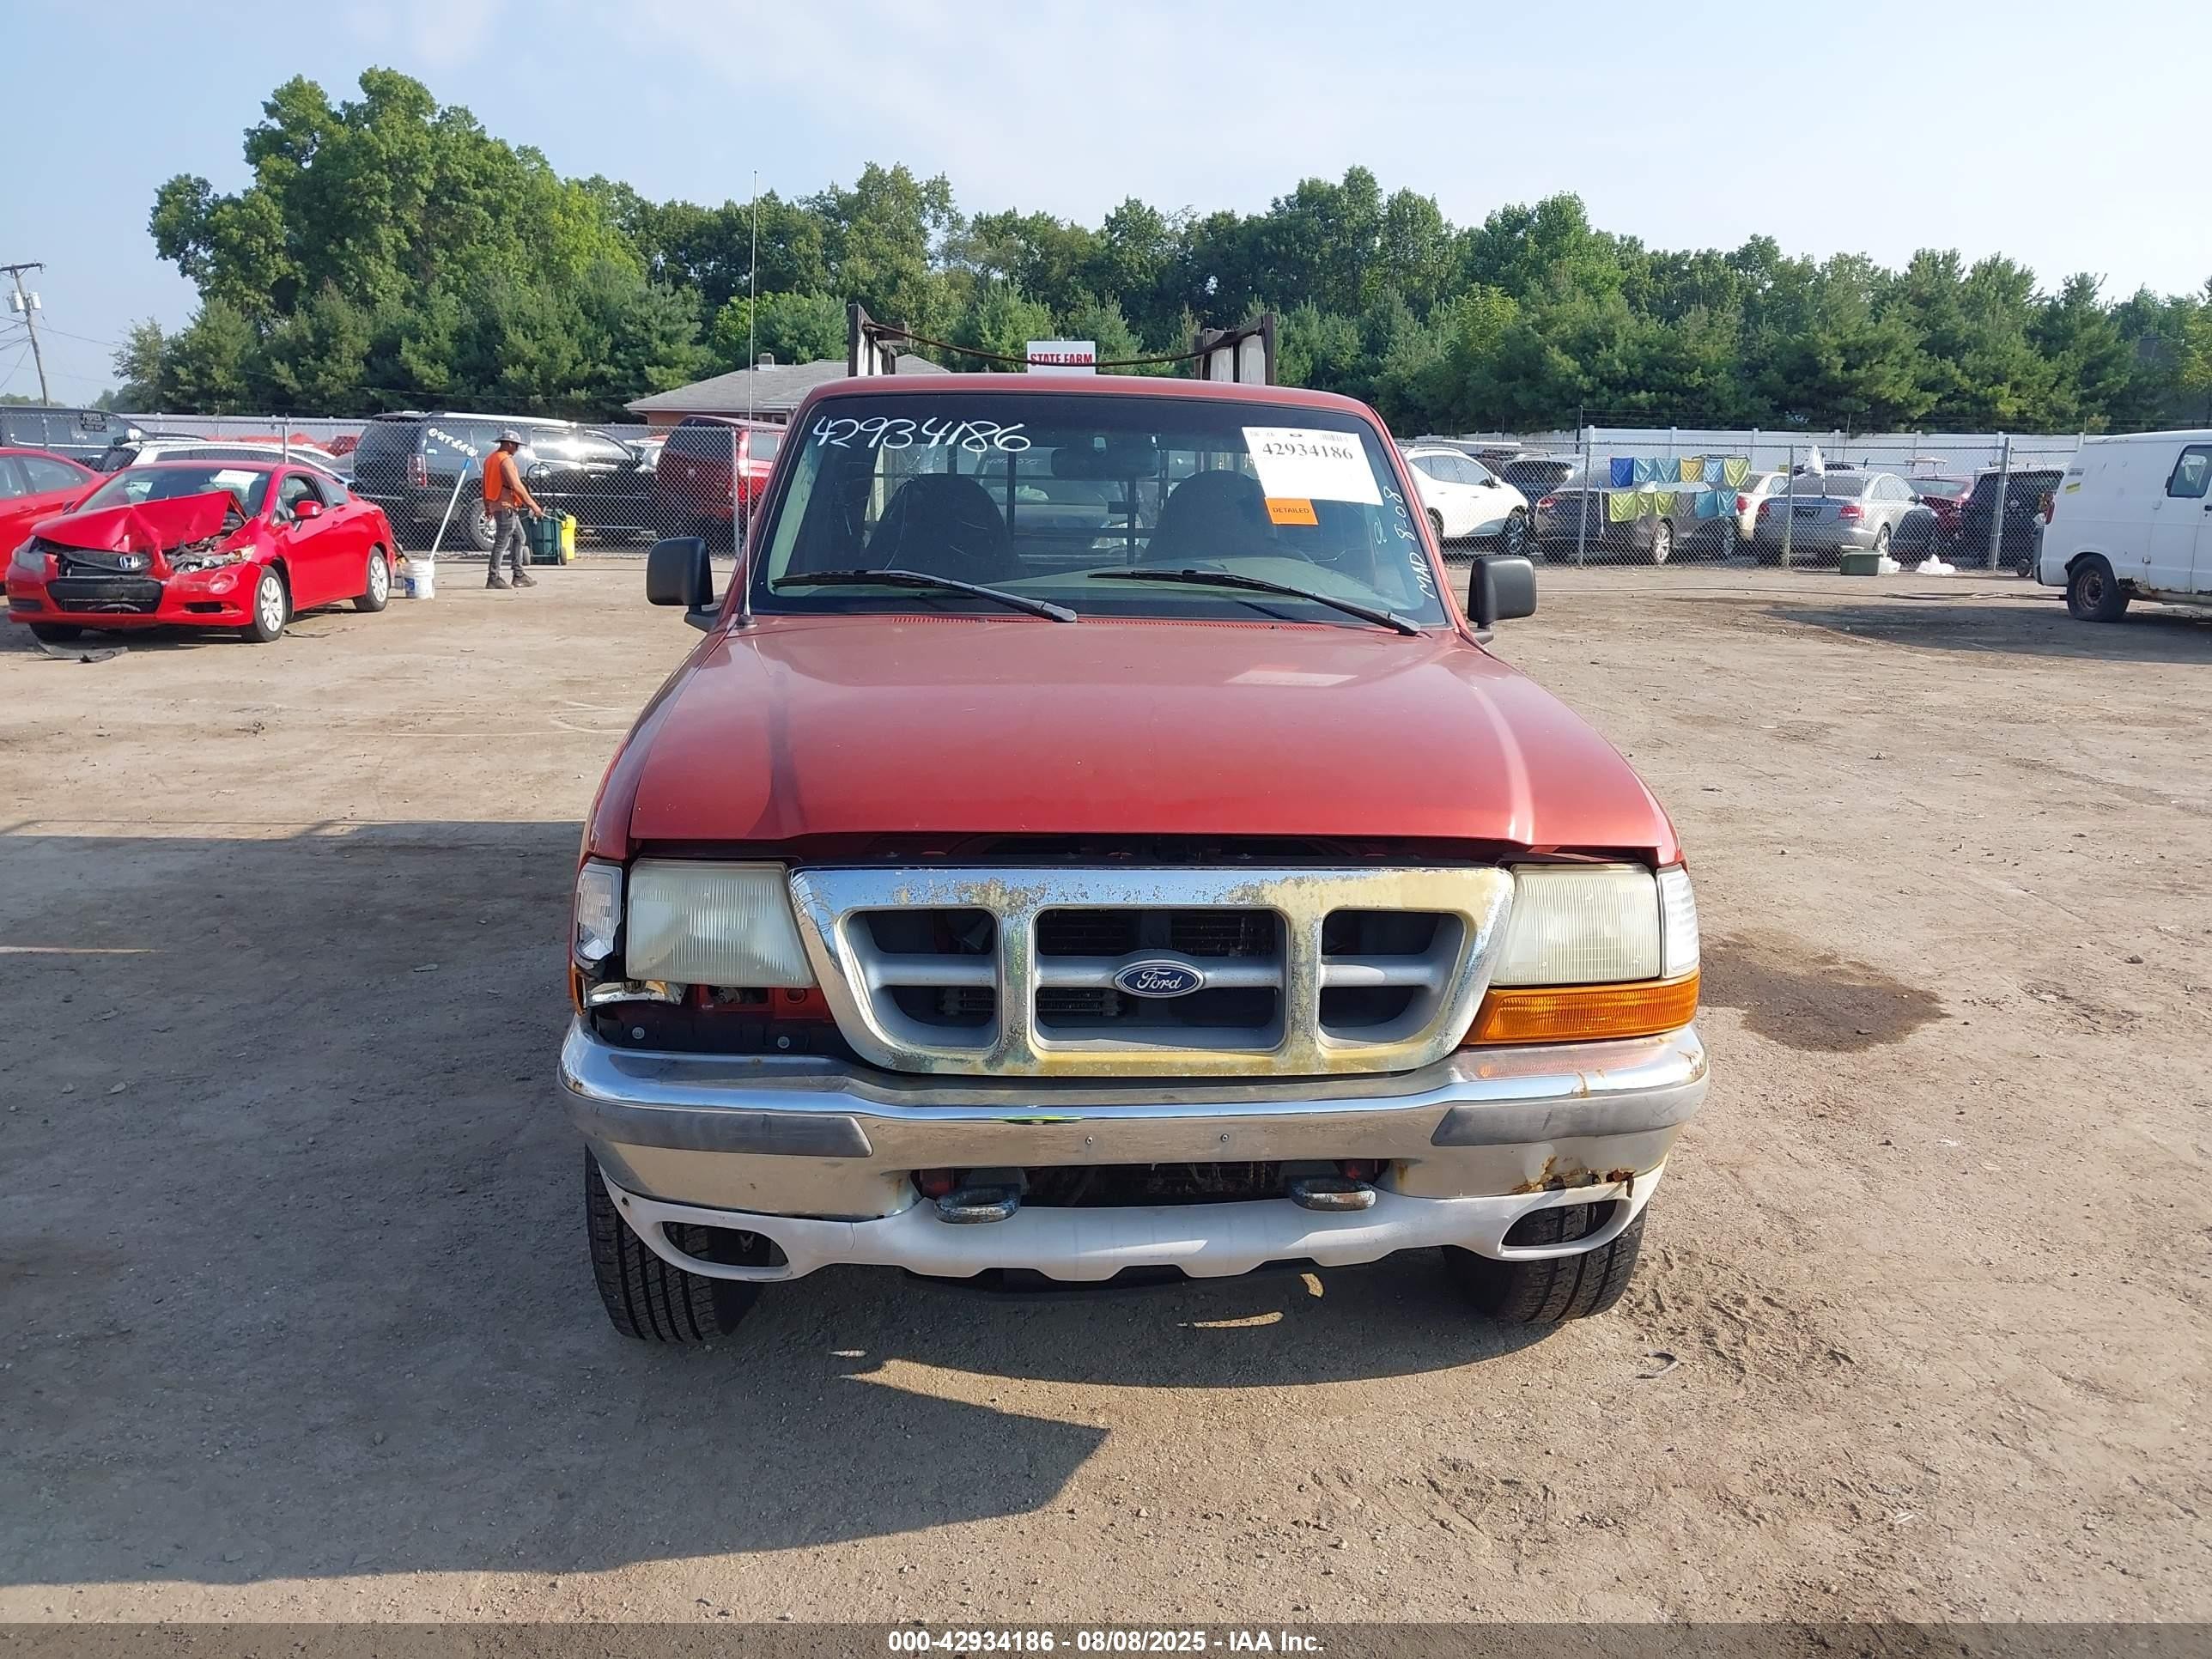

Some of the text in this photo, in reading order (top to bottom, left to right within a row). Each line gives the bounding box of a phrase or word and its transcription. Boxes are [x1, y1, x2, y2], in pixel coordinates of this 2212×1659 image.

[1030, 353, 1093, 367] STATE FARM
[812, 415, 1031, 453] 42934186
[1262, 442, 1353, 460] 42934186
[1136, 968, 1183, 989] Ford
